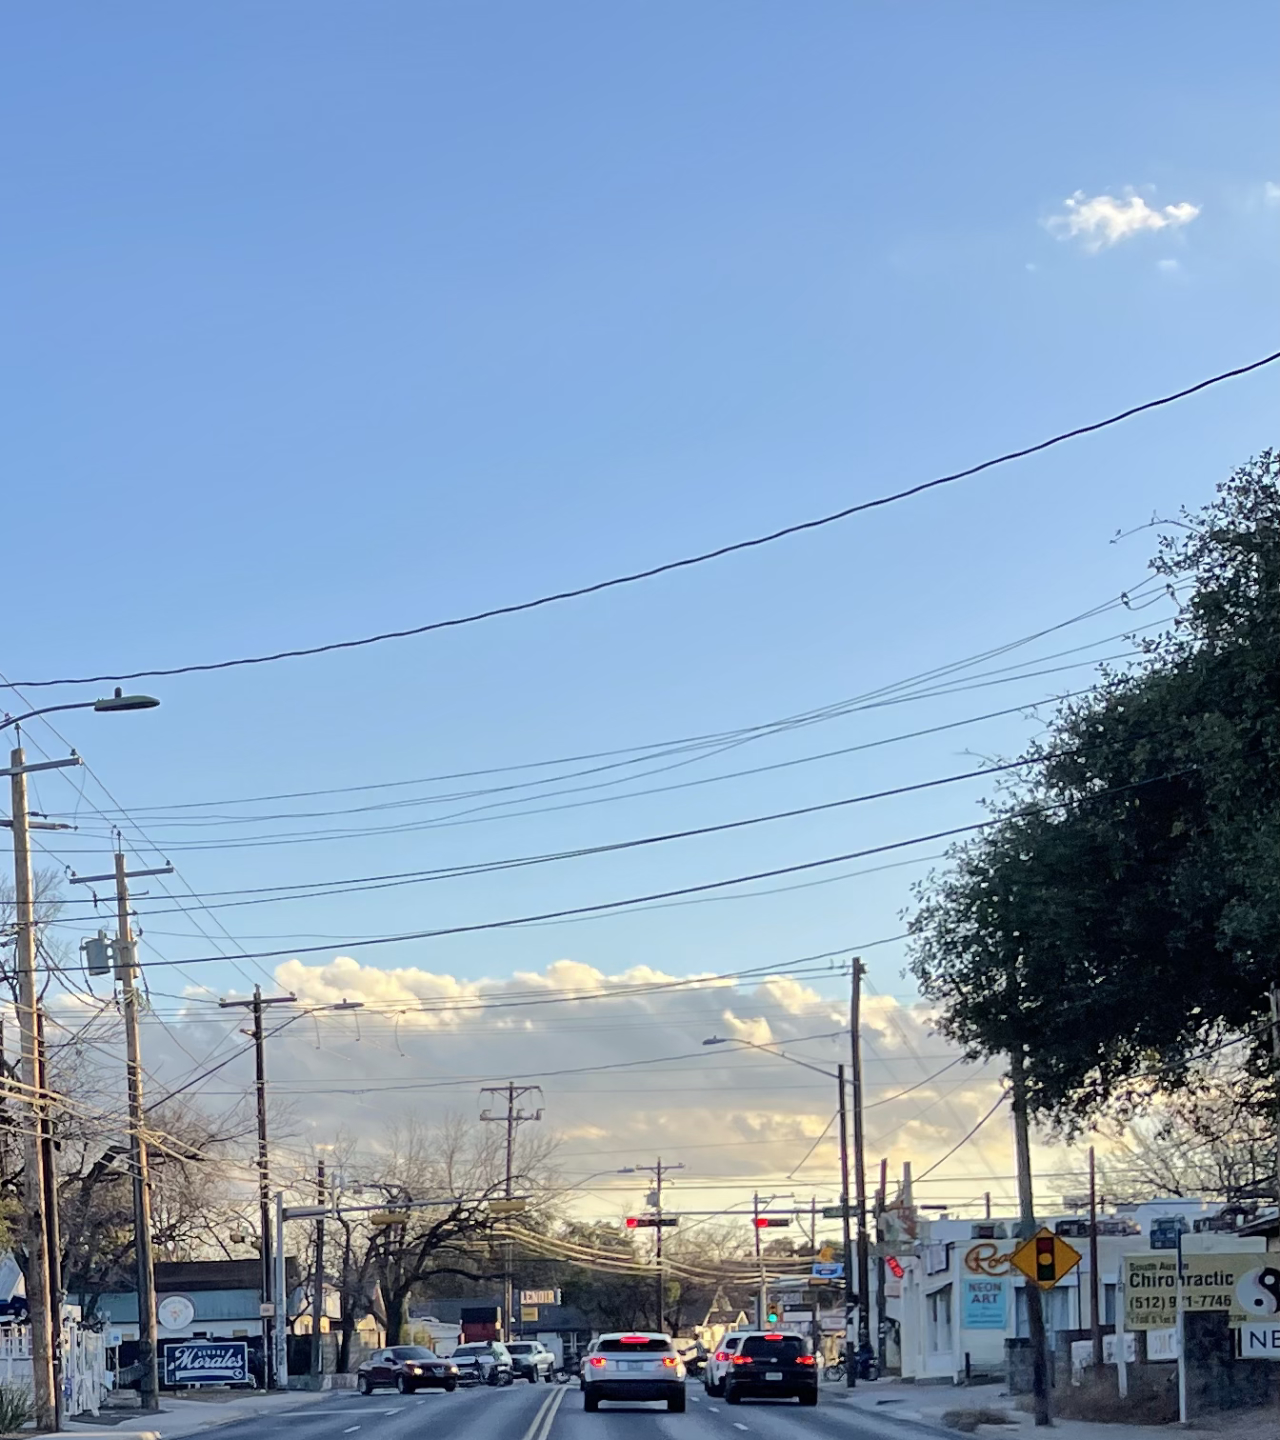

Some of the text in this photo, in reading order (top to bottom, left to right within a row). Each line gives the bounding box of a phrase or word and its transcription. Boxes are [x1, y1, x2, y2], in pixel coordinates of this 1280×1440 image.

[968, 1282, 1002, 1292] NEON
[971, 1294, 998, 1304] ART
[1130, 1295, 1231, 1311] (512) 91-7746
[168, 1347, 243, 1369] Morales
